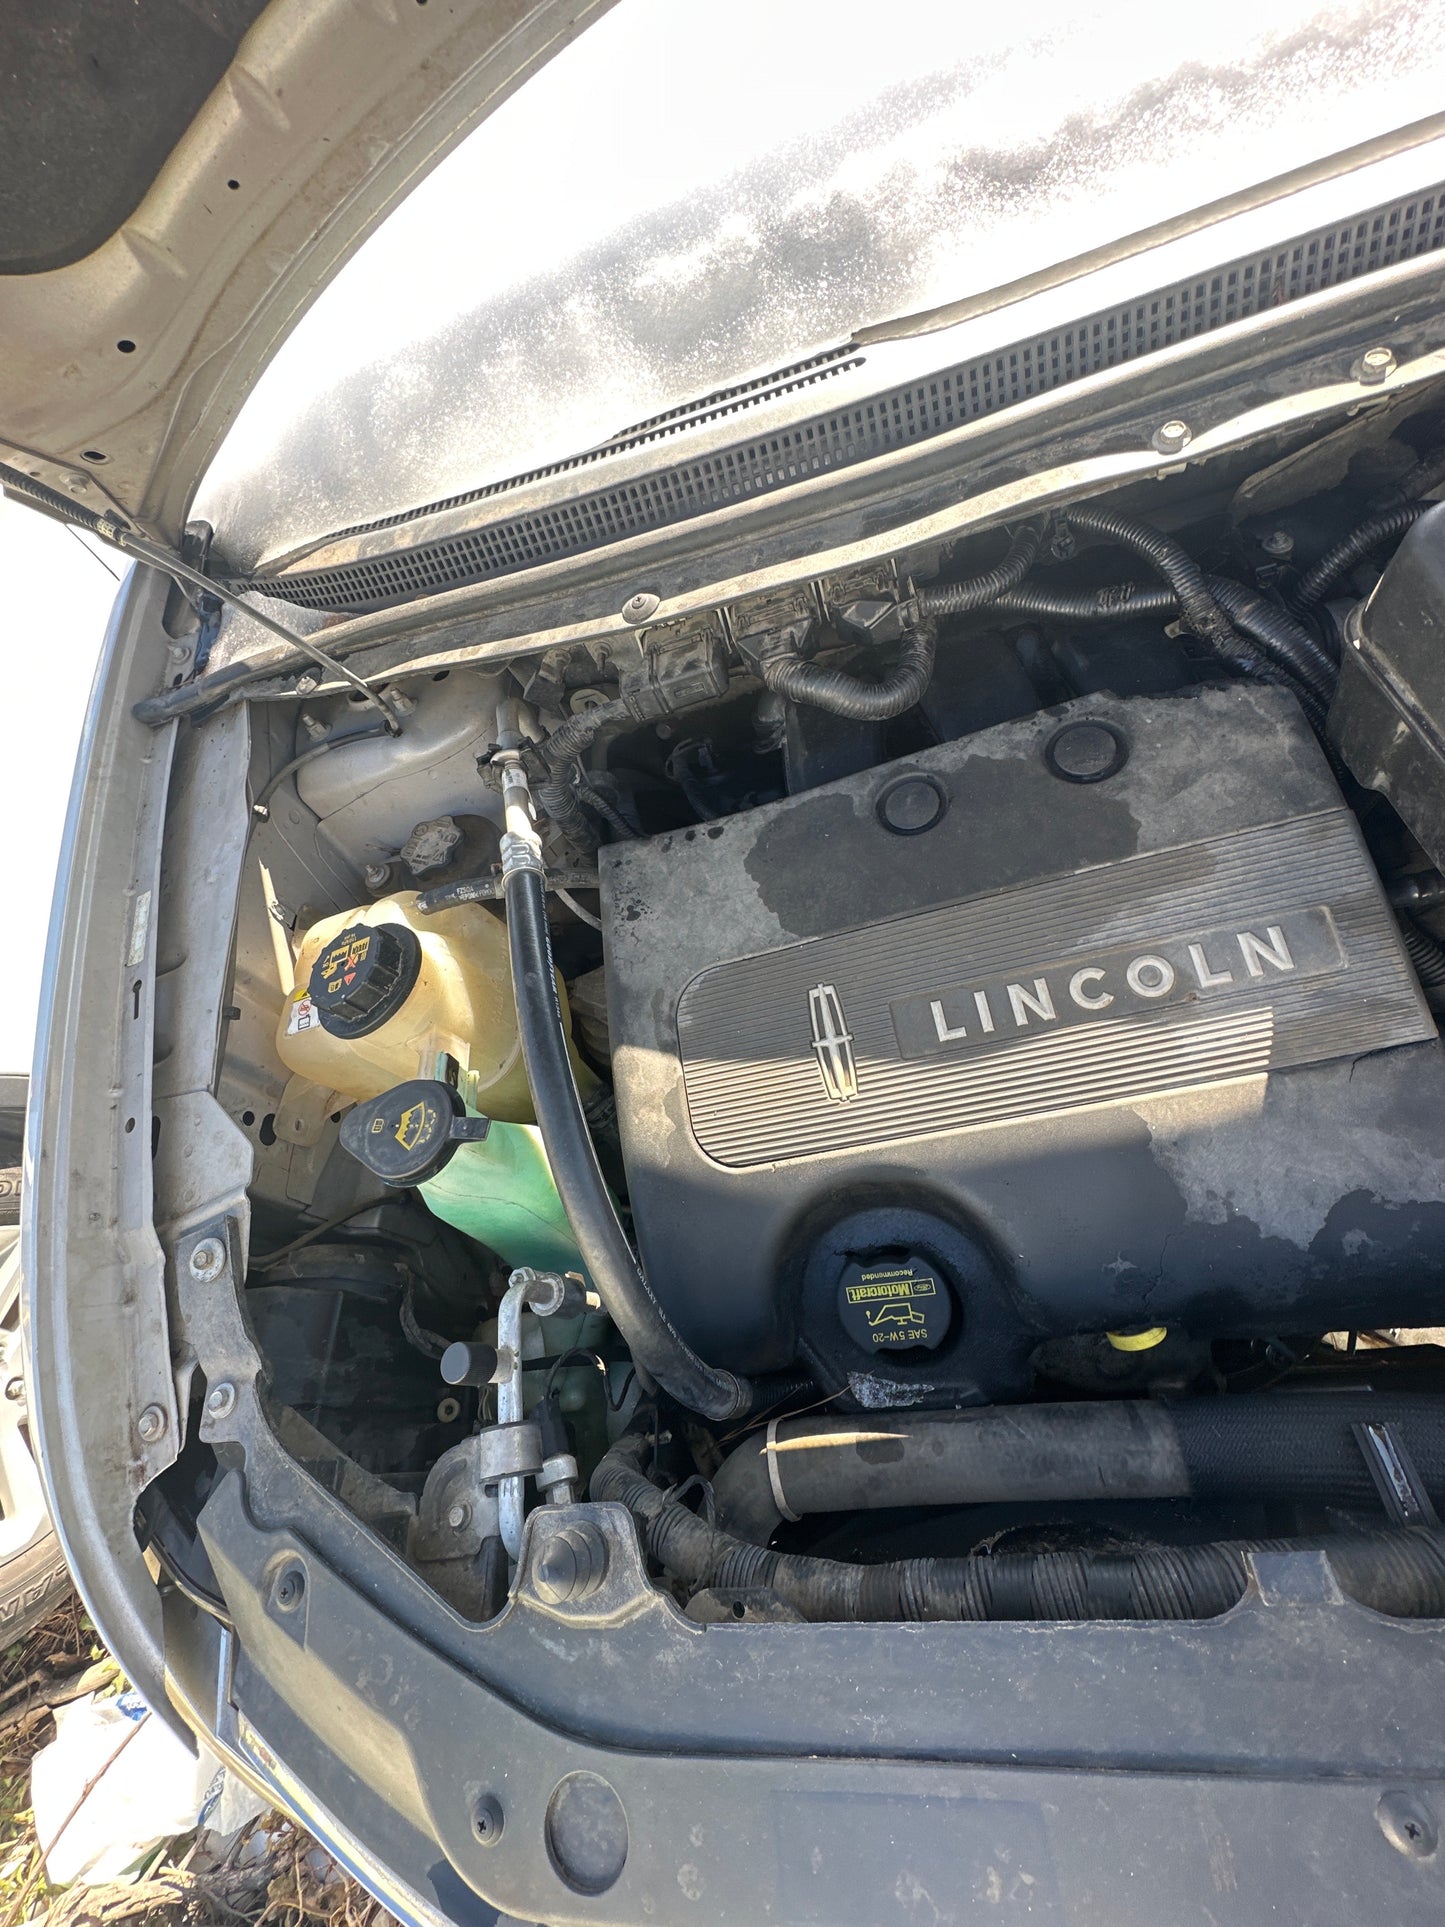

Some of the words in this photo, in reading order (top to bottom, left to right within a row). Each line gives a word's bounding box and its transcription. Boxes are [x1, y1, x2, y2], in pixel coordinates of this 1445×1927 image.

[930, 925, 1295, 1043] LINCOLN
[861, 1268, 914, 1281] Recommended
[849, 1283, 911, 1301] Motorcraft
[872, 1330, 906, 1343] 5W-20
[907, 1328, 928, 1340] SAE
